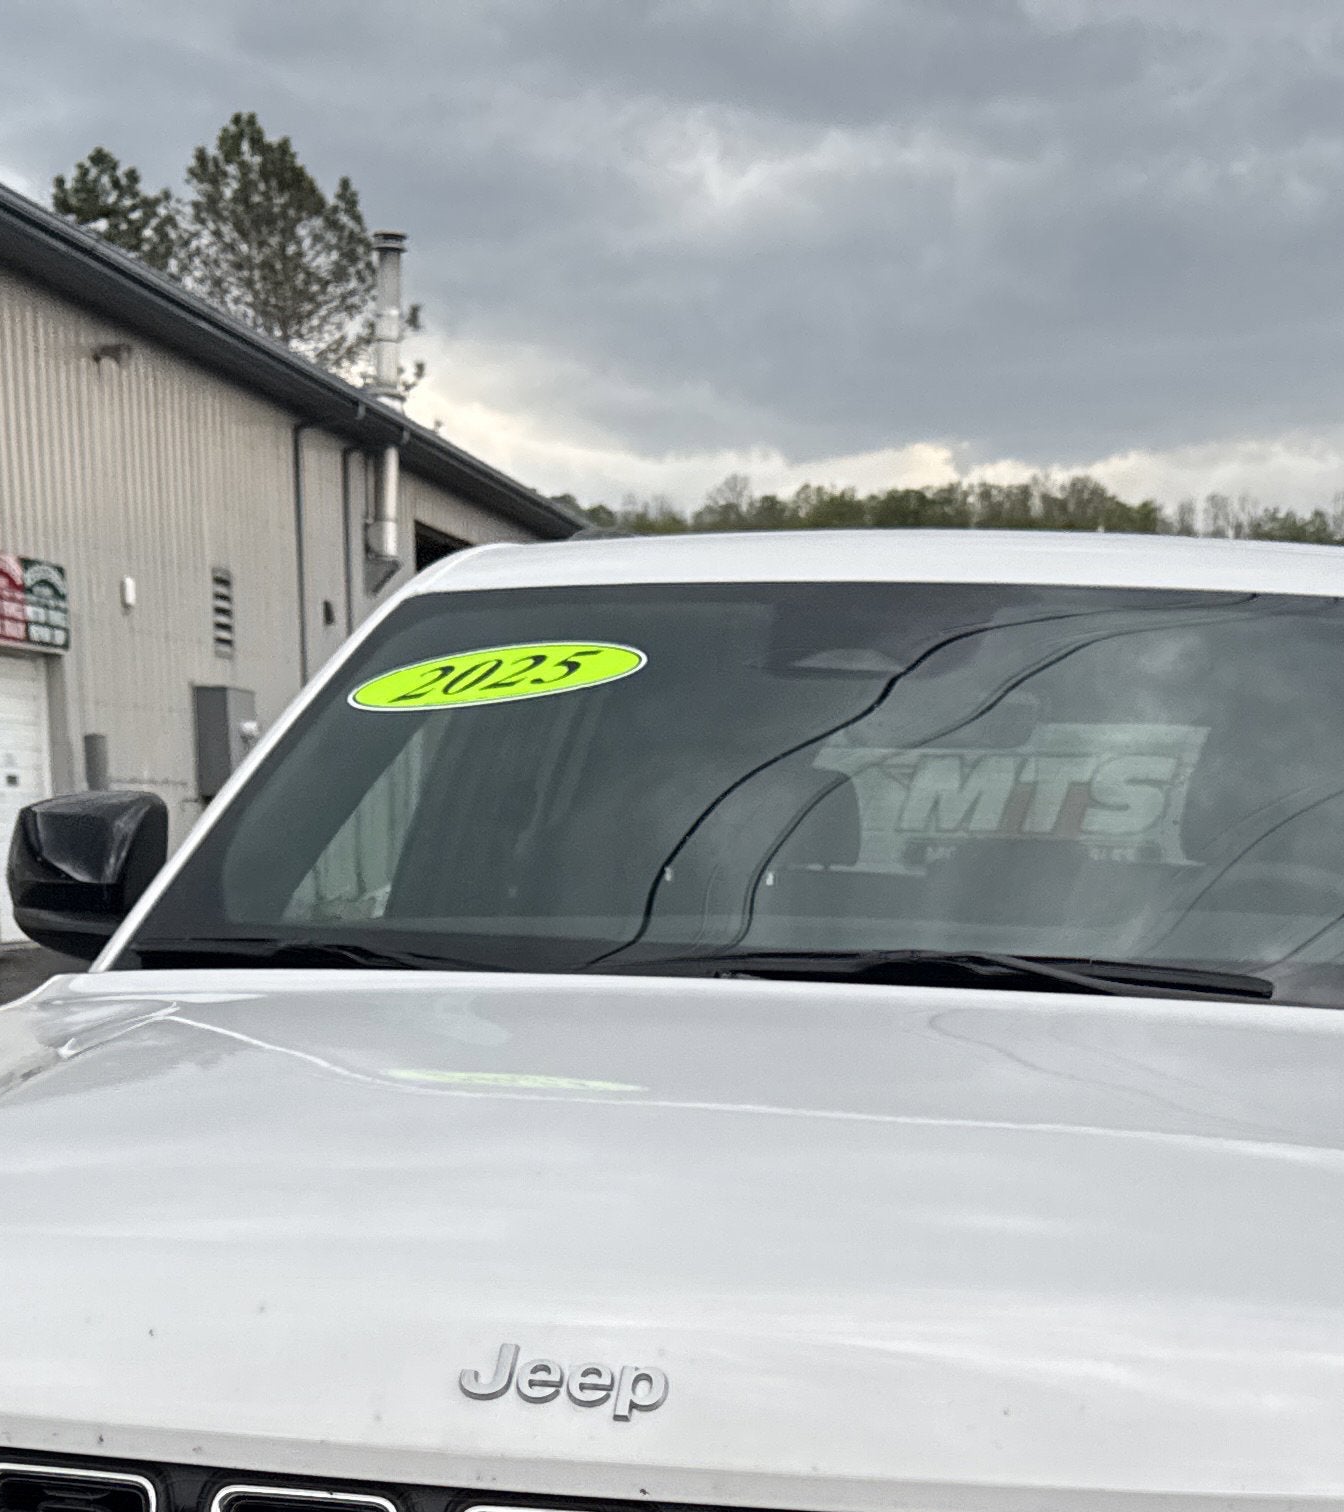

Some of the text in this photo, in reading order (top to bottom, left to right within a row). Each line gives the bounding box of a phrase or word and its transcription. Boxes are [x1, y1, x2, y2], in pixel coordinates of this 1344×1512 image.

[387, 649, 603, 704] 2025
[898, 753, 1181, 836] MTS
[458, 1342, 670, 1422] Jeep
